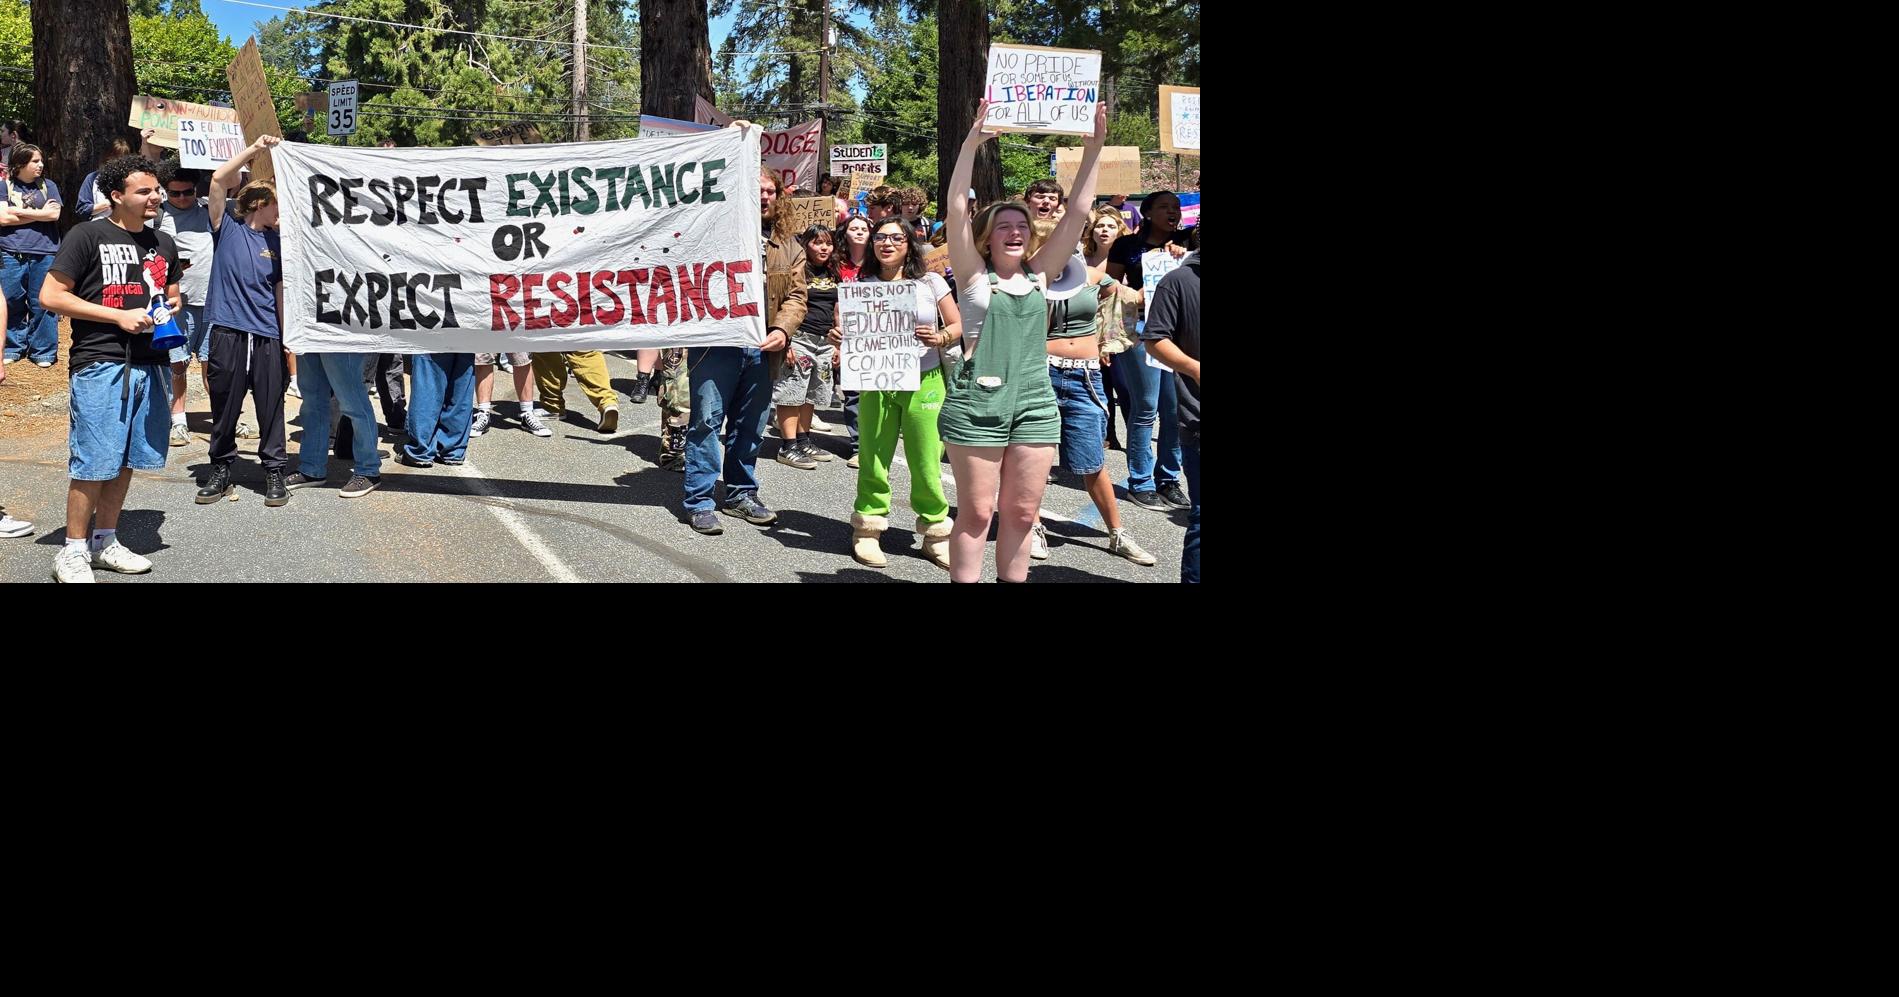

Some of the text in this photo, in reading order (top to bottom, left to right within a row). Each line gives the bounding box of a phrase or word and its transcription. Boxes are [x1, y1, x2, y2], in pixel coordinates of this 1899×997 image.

[996, 53, 1086, 75] NO PRIDE
[992, 72, 1072, 85] FOR SOME OF US
[1068, 80, 1099, 88] WITHOUT
[331, 86, 356, 96] SPEED
[989, 84, 1095, 104] LIBERATION
[333, 98, 352, 107] LIMIT
[330, 109, 353, 129] 35
[987, 102, 1089, 122] FOR ALL OF US
[181, 120, 195, 132] IS
[181, 138, 206, 156] TOO
[308, 158, 726, 227] RESPECT EXISTANCE
[791, 199, 823, 211] WE
[795, 210, 832, 220] ESERVE
[491, 222, 550, 261] OR
[99, 243, 139, 264] GREEN
[102, 263, 127, 285] DAY
[102, 284, 144, 295] american
[315, 259, 759, 331] EXPECT RESISTANCE
[842, 283, 914, 299] THIS IS NOT
[102, 294, 124, 307] idiot
[862, 300, 890, 312] THE
[842, 310, 918, 336] EDUCATION
[844, 334, 919, 354] I CAME TO THIS
[848, 353, 919, 371] COUNTRY
[860, 372, 905, 389] FOR
